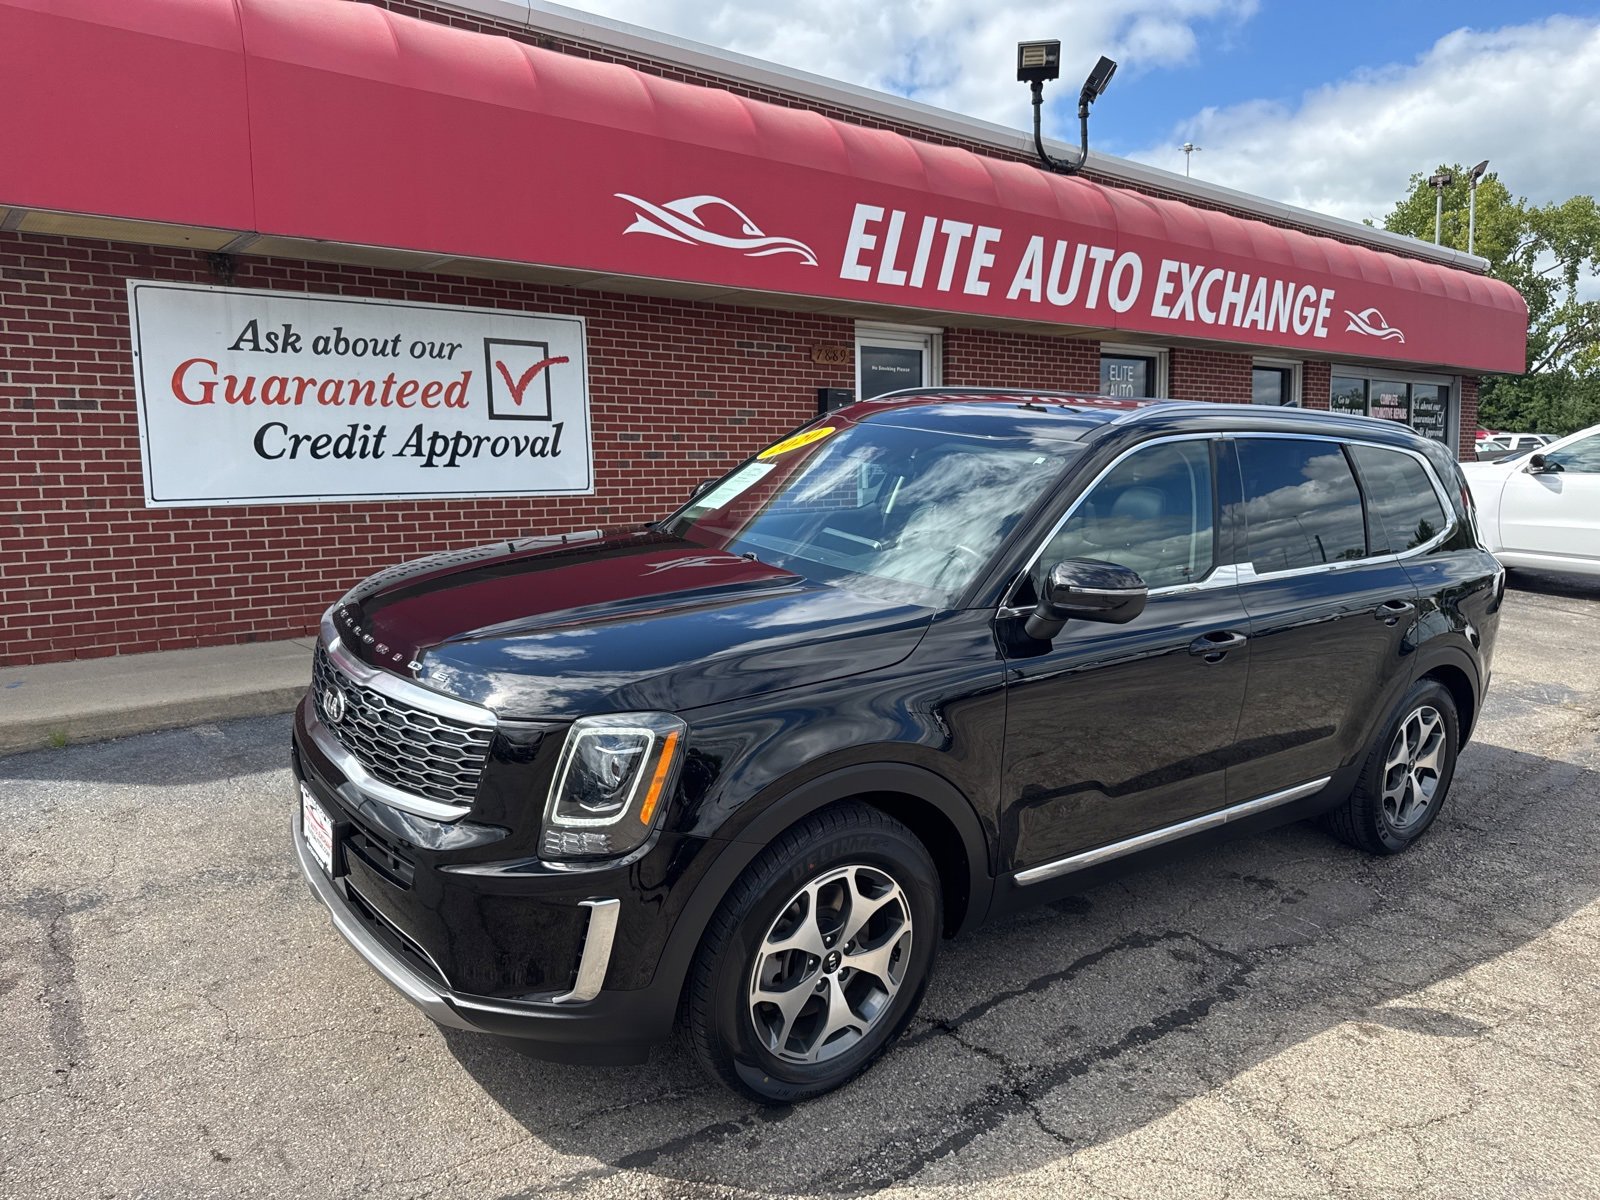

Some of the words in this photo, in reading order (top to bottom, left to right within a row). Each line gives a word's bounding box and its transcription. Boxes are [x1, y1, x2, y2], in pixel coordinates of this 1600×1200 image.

[839, 202, 1003, 297] ELITE
[1005, 235, 1143, 313] AUTO
[1150, 258, 1336, 339] EXCHANGE
[227, 318, 303, 354] Ask
[312, 326, 402, 358] about
[409, 340, 463, 361] our
[816, 349, 847, 363] 7889
[879, 365, 896, 373] Smoking
[171, 357, 473, 409] Guaranteed
[1110, 365, 1134, 381] ELITE
[1110, 384, 1134, 397] AUTO
[253, 421, 387, 460] Credit
[392, 421, 565, 469] Approval
